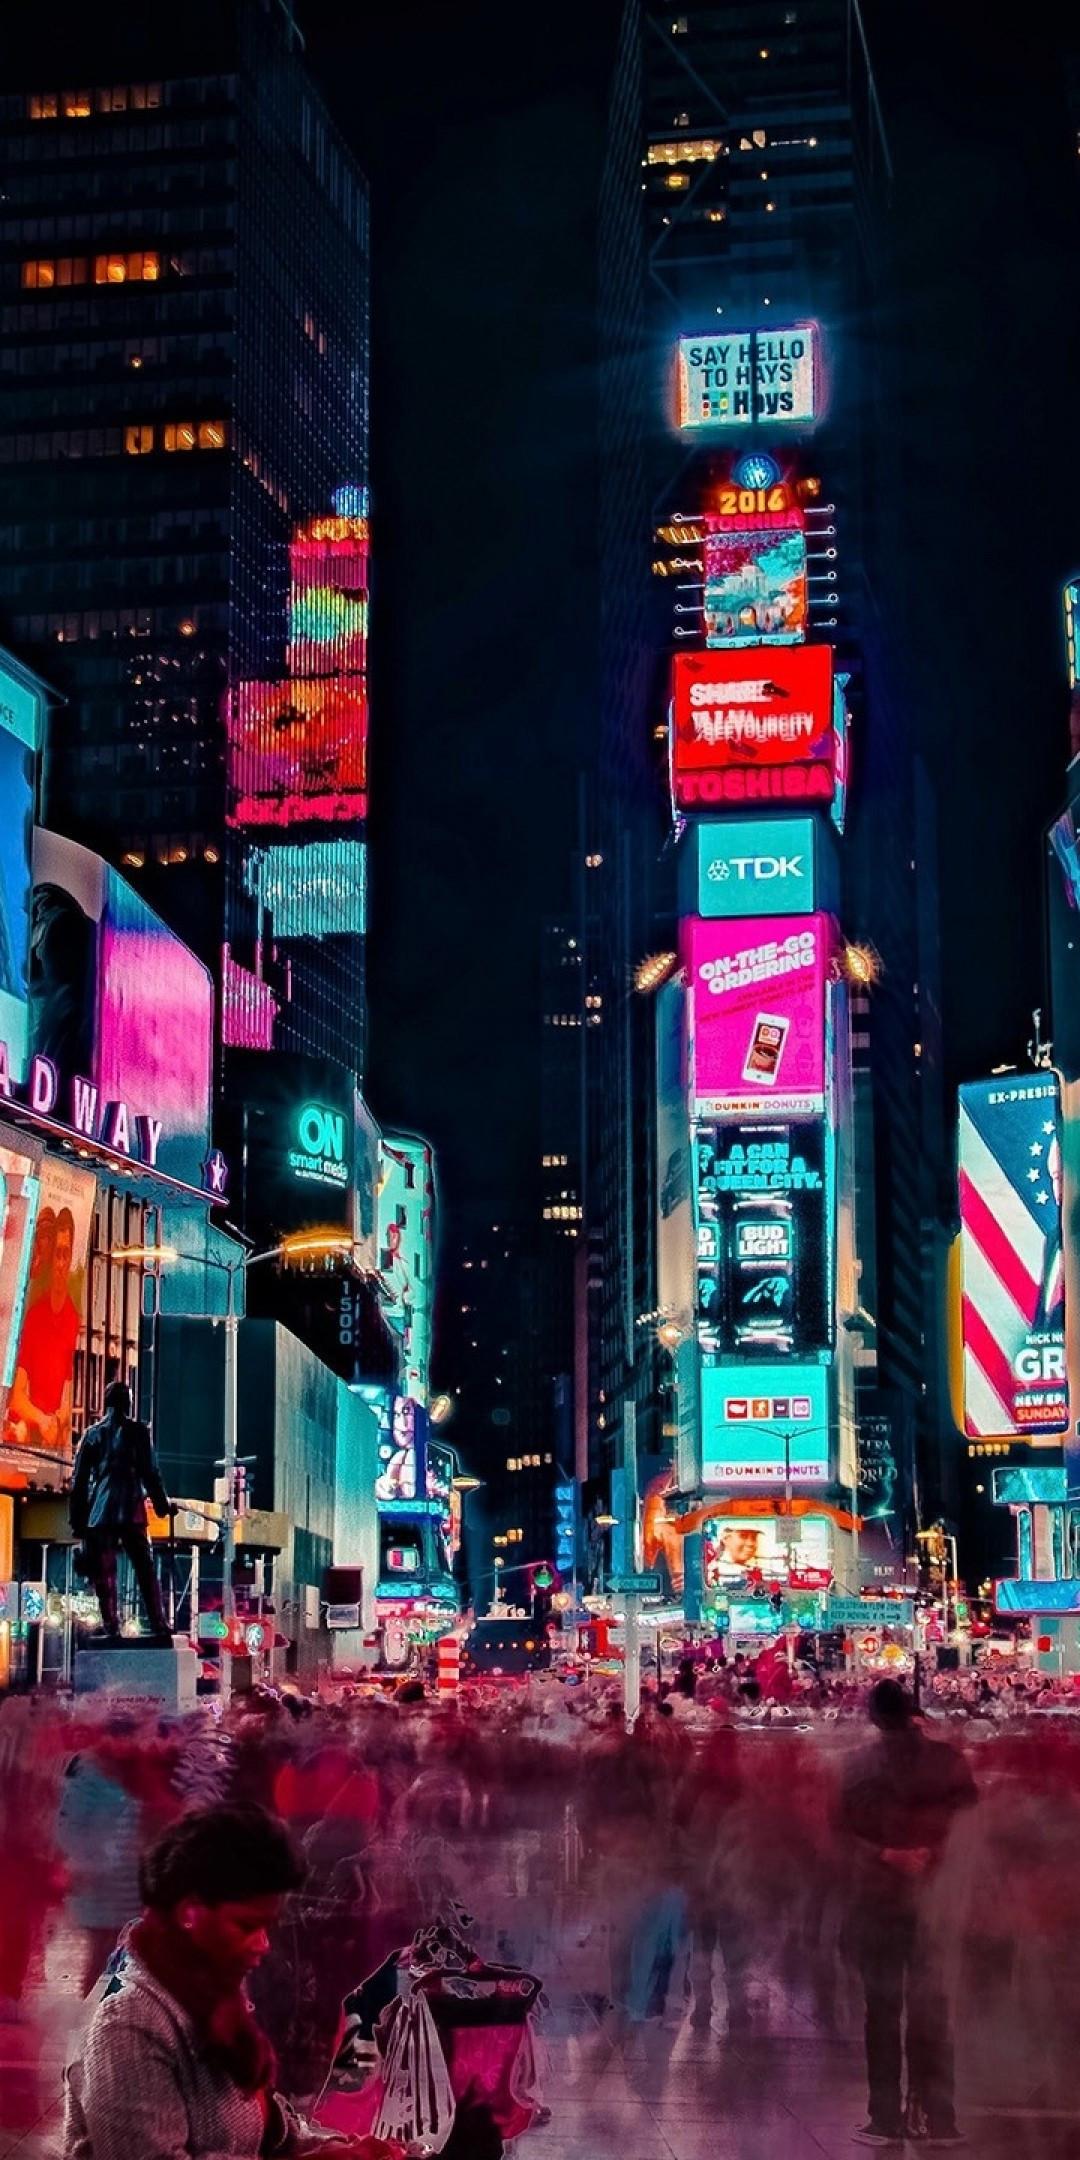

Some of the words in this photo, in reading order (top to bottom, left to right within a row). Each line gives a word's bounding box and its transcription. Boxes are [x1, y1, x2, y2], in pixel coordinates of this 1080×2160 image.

[690, 344, 729, 366] SAY
[739, 340, 804, 363] HELLO
[701, 368, 727, 387] TO
[736, 363, 792, 385] HAYS
[734, 391, 793, 415] Hays
[720, 488, 784, 515] 2016
[704, 510, 803, 531] TOSHIBA
[680, 765, 831, 800] TOSHIBA
[729, 855, 804, 880] TDK
[699, 932, 815, 980] ON-THE-GO
[708, 950, 815, 994] ORDERING
[764, 1100, 811, 1110] DONUTS
[300, 1109, 343, 1161] ON
[290, 1152, 323, 1172] smart
[729, 1144, 745, 1160] A
[747, 1143, 789, 1159] CAN
[714, 1160, 743, 1175] FIT
[747, 1159, 788, 1174] FOR
[791, 1157, 806, 1172] A
[703, 1173, 768, 1192] QUEEN
[744, 1225, 784, 1240] BUD
[740, 1239, 789, 1255] LIGHT
[340, 1281, 352, 1345] 1500
[1015, 1394, 1045, 1407] NEW
[1016, 1406, 1066, 1420] SUNDAY
[776, 1465, 820, 1475] DONUTS
